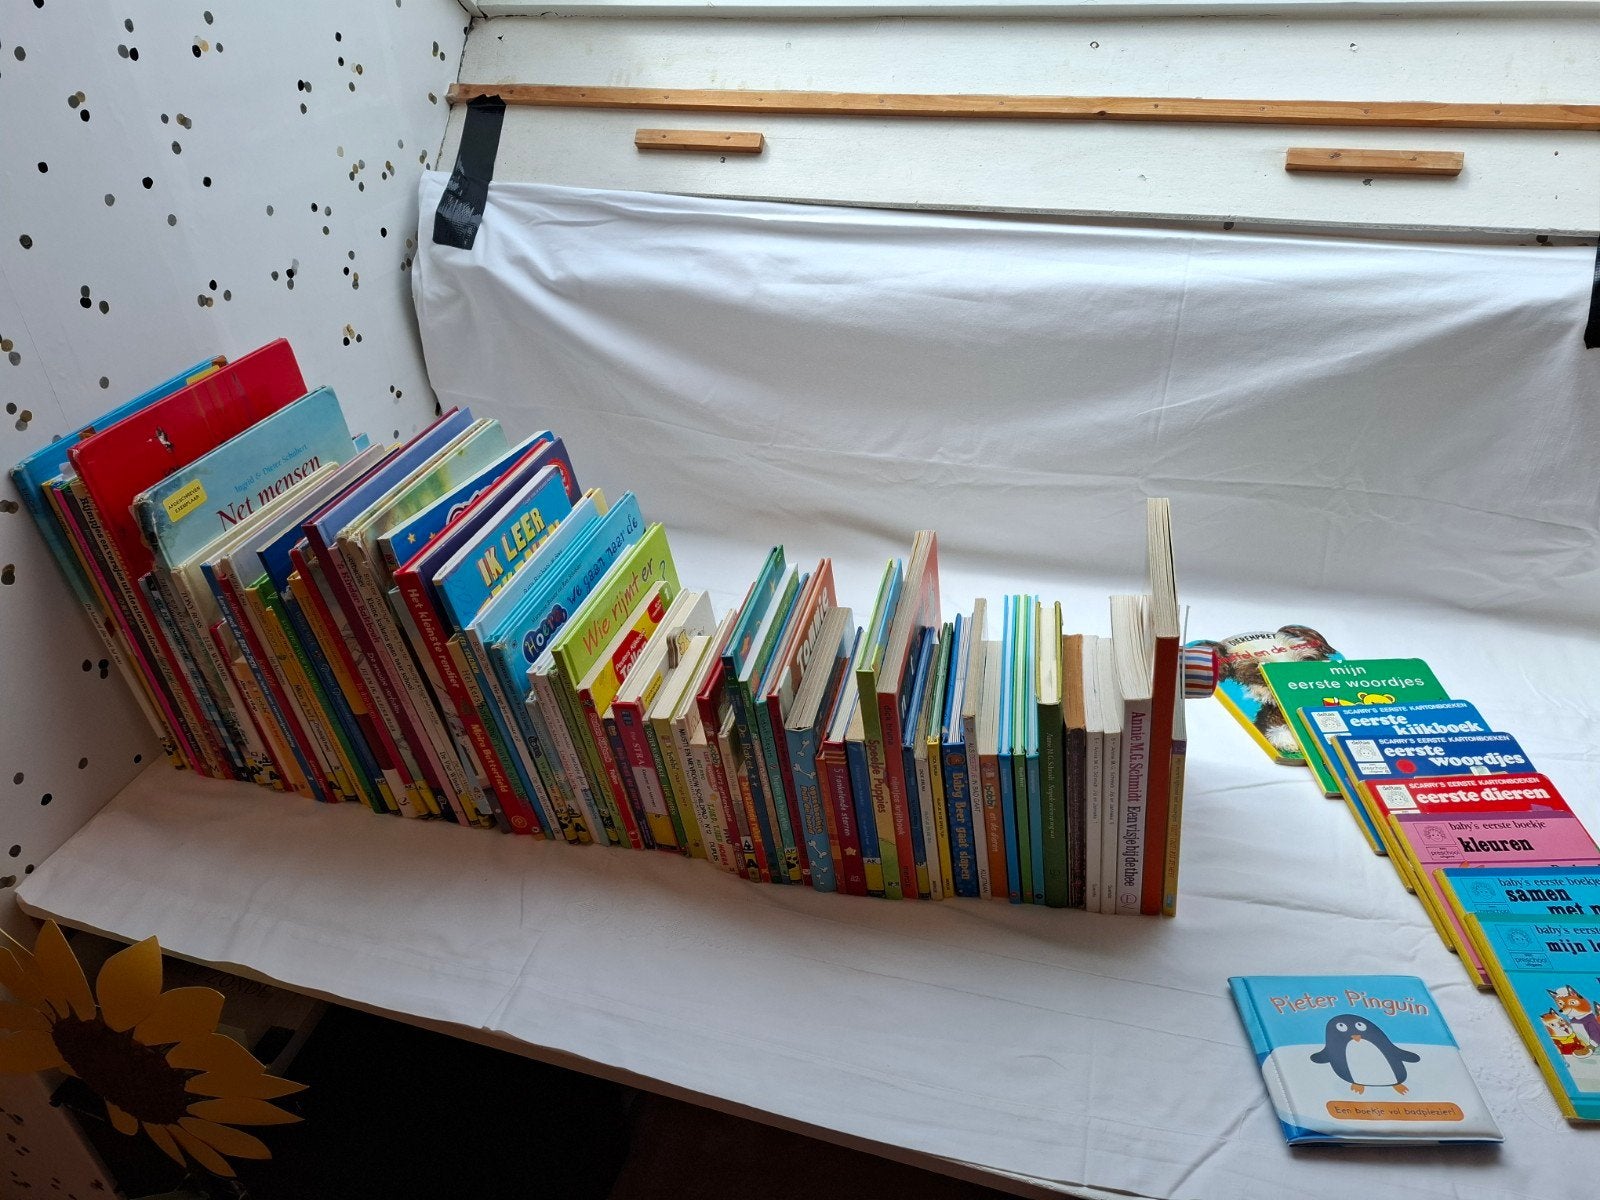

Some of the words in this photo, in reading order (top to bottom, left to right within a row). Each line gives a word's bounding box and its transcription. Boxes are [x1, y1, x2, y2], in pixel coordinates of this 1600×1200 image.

[216, 502, 254, 531] Net
[257, 455, 322, 506] mensen
[77, 495, 105, 539] Rijmpjes
[626, 514, 638, 535] de
[100, 538, 109, 550] en
[478, 546, 504, 587] IK
[501, 507, 546, 562] LEER
[104, 549, 125, 582] versjes
[120, 580, 132, 594] uit
[127, 593, 137, 605] de
[582, 617, 610, 656] Wie
[611, 571, 640, 621] rijmt
[641, 558, 653, 583] er
[132, 604, 151, 635] nieuwe
[146, 633, 161, 654] doos
[365, 596, 380, 617] Kleine
[400, 671, 414, 691] school
[407, 588, 423, 609] Het
[418, 610, 442, 652] kleinste
[438, 653, 461, 689] rendier
[1329, 664, 1367, 677] mijn
[1288, 679, 1341, 690] eerste
[1345, 677, 1425, 690] woordjes
[882, 704, 892, 720] dick
[1409, 702, 1468, 712] KARTONBOEKEN
[1131, 711, 1146, 741] Annie
[1350, 714, 1408, 727] eerste
[1393, 720, 1485, 736] kijkboek
[737, 723, 748, 738] De
[885, 722, 896, 745] bruna
[1379, 737, 1416, 745] SCARRY'S
[1417, 736, 1448, 744] EERSTE
[1448, 735, 1510, 743] KARTONBOEKEN
[470, 723, 487, 747] Moira
[483, 747, 510, 795] Butterfield
[684, 747, 691, 757] EN
[739, 741, 757, 770] Raket
[866, 738, 885, 775] Speelse
[1384, 745, 1445, 757] eerste
[1428, 752, 1525, 768] woordjes
[948, 771, 967, 798] Baby
[1408, 782, 1446, 790] SCARRY'S
[1447, 780, 1477, 788] EERSTE
[1477, 777, 1540, 786] KARTONBOEKEN
[871, 776, 890, 814] Puppies
[1416, 790, 1480, 804] eerste
[1481, 786, 1551, 803] dieren
[835, 774, 847, 810] fonkelende
[841, 812, 850, 836] sterren
[953, 801, 967, 823] Beer
[972, 797, 980, 813] GAAT
[988, 812, 996, 821] en
[1126, 805, 1140, 824] Een
[990, 822, 997, 831] de
[1122, 824, 1139, 844] visje
[1449, 821, 1479, 832] baby's
[1482, 822, 1512, 830] eerste
[1513, 820, 1547, 831] boekje
[955, 826, 968, 847] gaat
[989, 832, 999, 852] dieren
[1457, 837, 1535, 853] kleuren
[1122, 844, 1138, 857] bij
[956, 850, 972, 880] slapen
[1125, 856, 1138, 867] de
[1123, 867, 1138, 886] thee
[1497, 878, 1530, 889] baby's
[1534, 878, 1566, 887] eerste
[1505, 888, 1573, 902] samen
[1546, 903, 1585, 915] met
[1534, 925, 1570, 937] baby's
[1573, 926, 1600, 935] eerst
[1545, 939, 1588, 956] mijn
[1270, 993, 1338, 1014] Pieter
[1344, 989, 1430, 1016] Pinguïn
[1334, 1106, 1351, 1114] Een
[1355, 1106, 1385, 1116] boekje
[1389, 1106, 1401, 1114] vol
[1404, 1106, 1456, 1118] badplezier!
